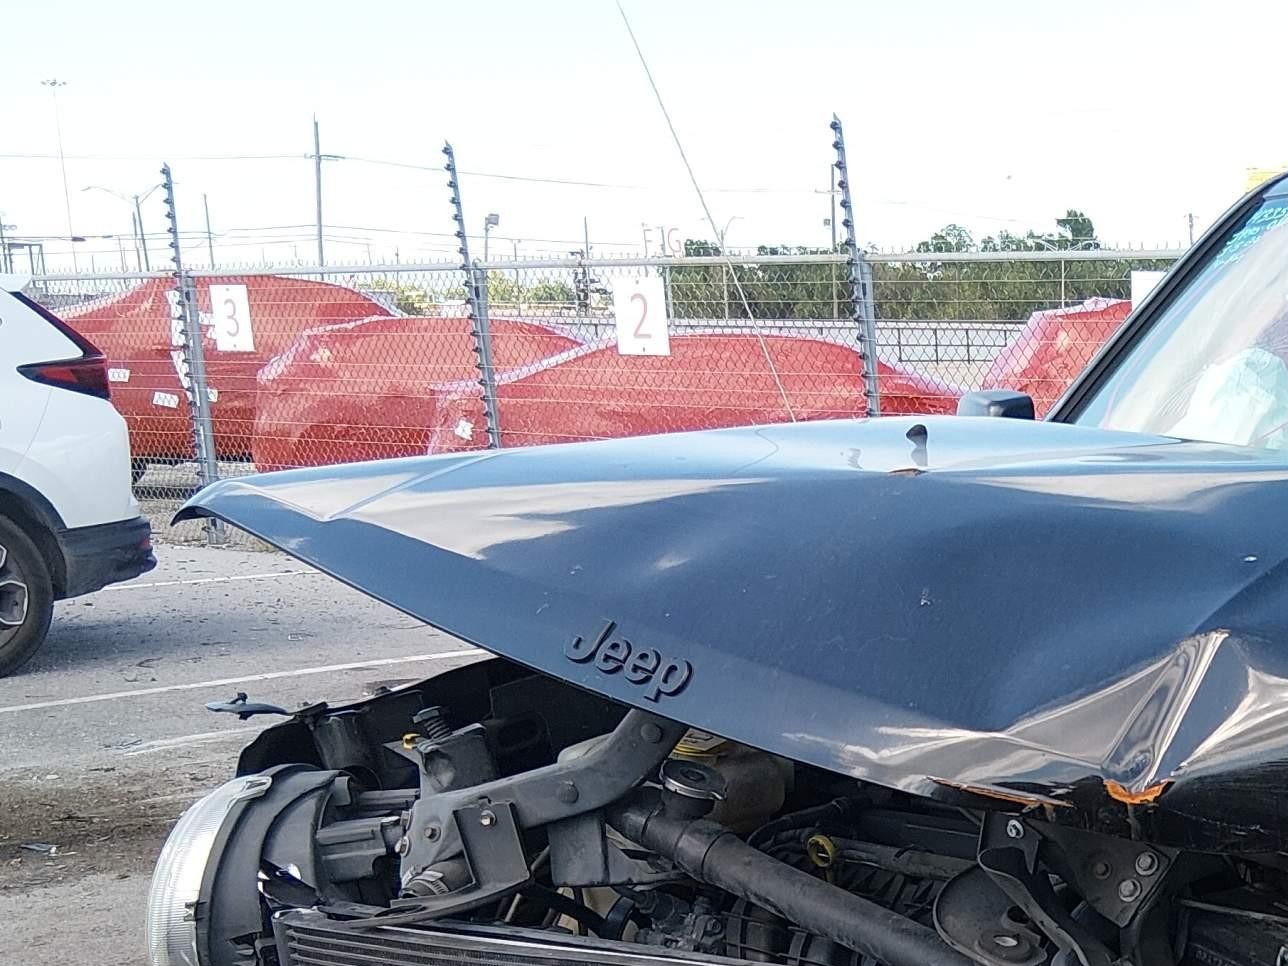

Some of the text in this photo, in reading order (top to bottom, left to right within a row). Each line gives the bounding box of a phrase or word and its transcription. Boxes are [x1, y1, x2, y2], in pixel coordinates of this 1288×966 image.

[224, 298, 240, 337] 3
[630, 293, 653, 339] 2
[563, 617, 694, 704] Jeep
